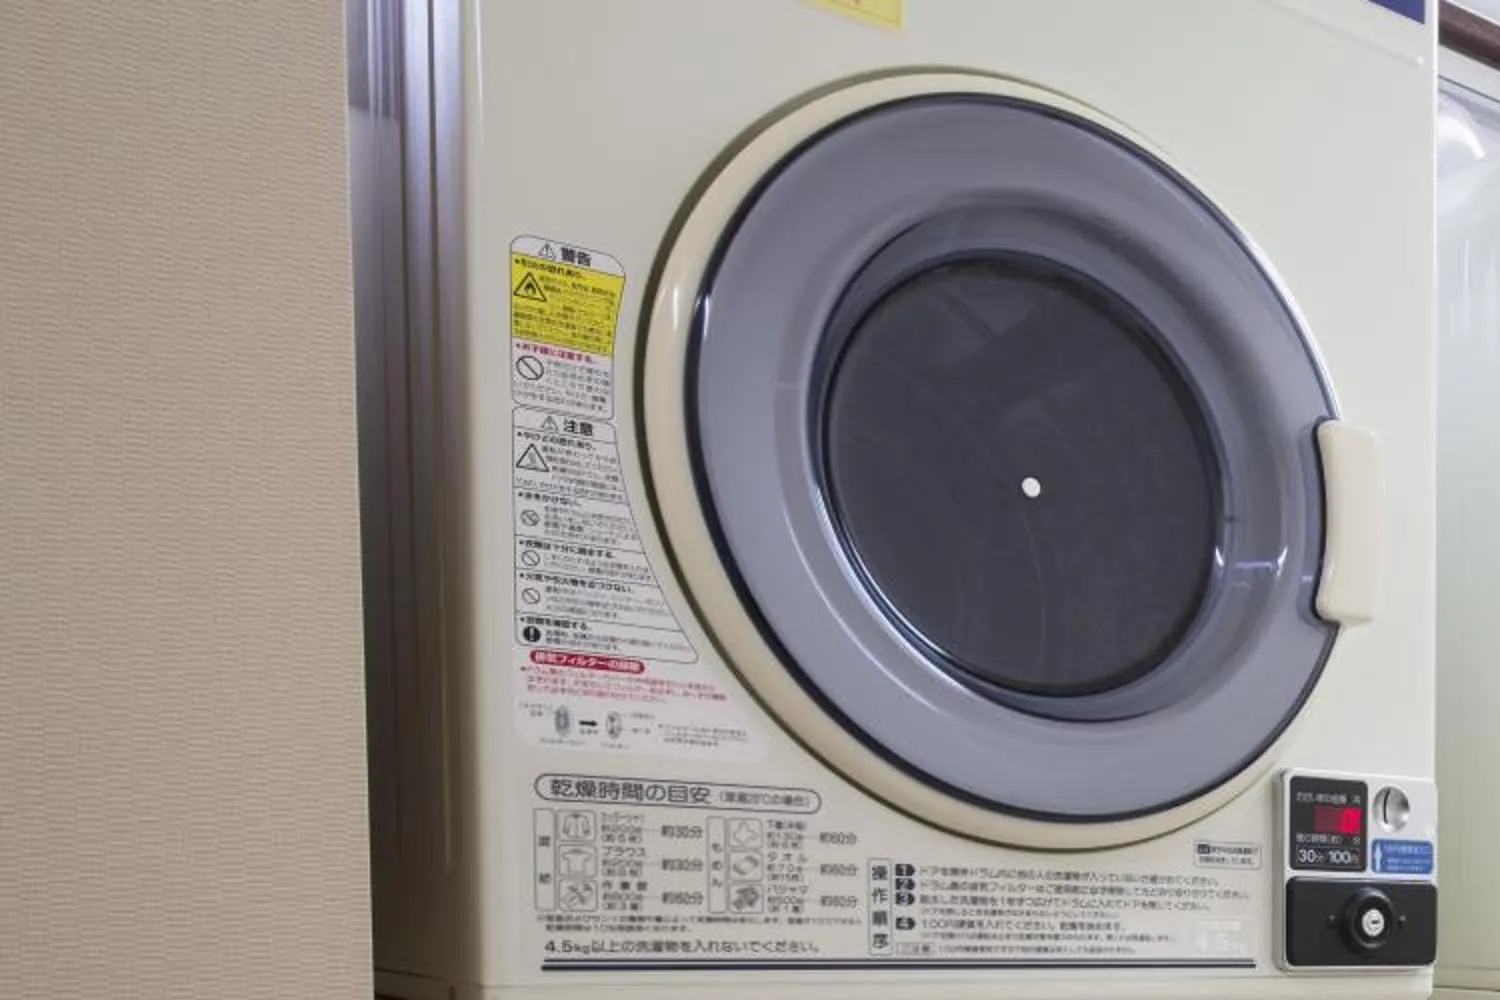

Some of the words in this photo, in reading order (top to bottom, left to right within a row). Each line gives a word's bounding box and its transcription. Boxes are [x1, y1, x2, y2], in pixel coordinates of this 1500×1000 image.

[563, 418, 593, 437] 注意
[551, 779, 712, 804] 乾燥時間の目安
